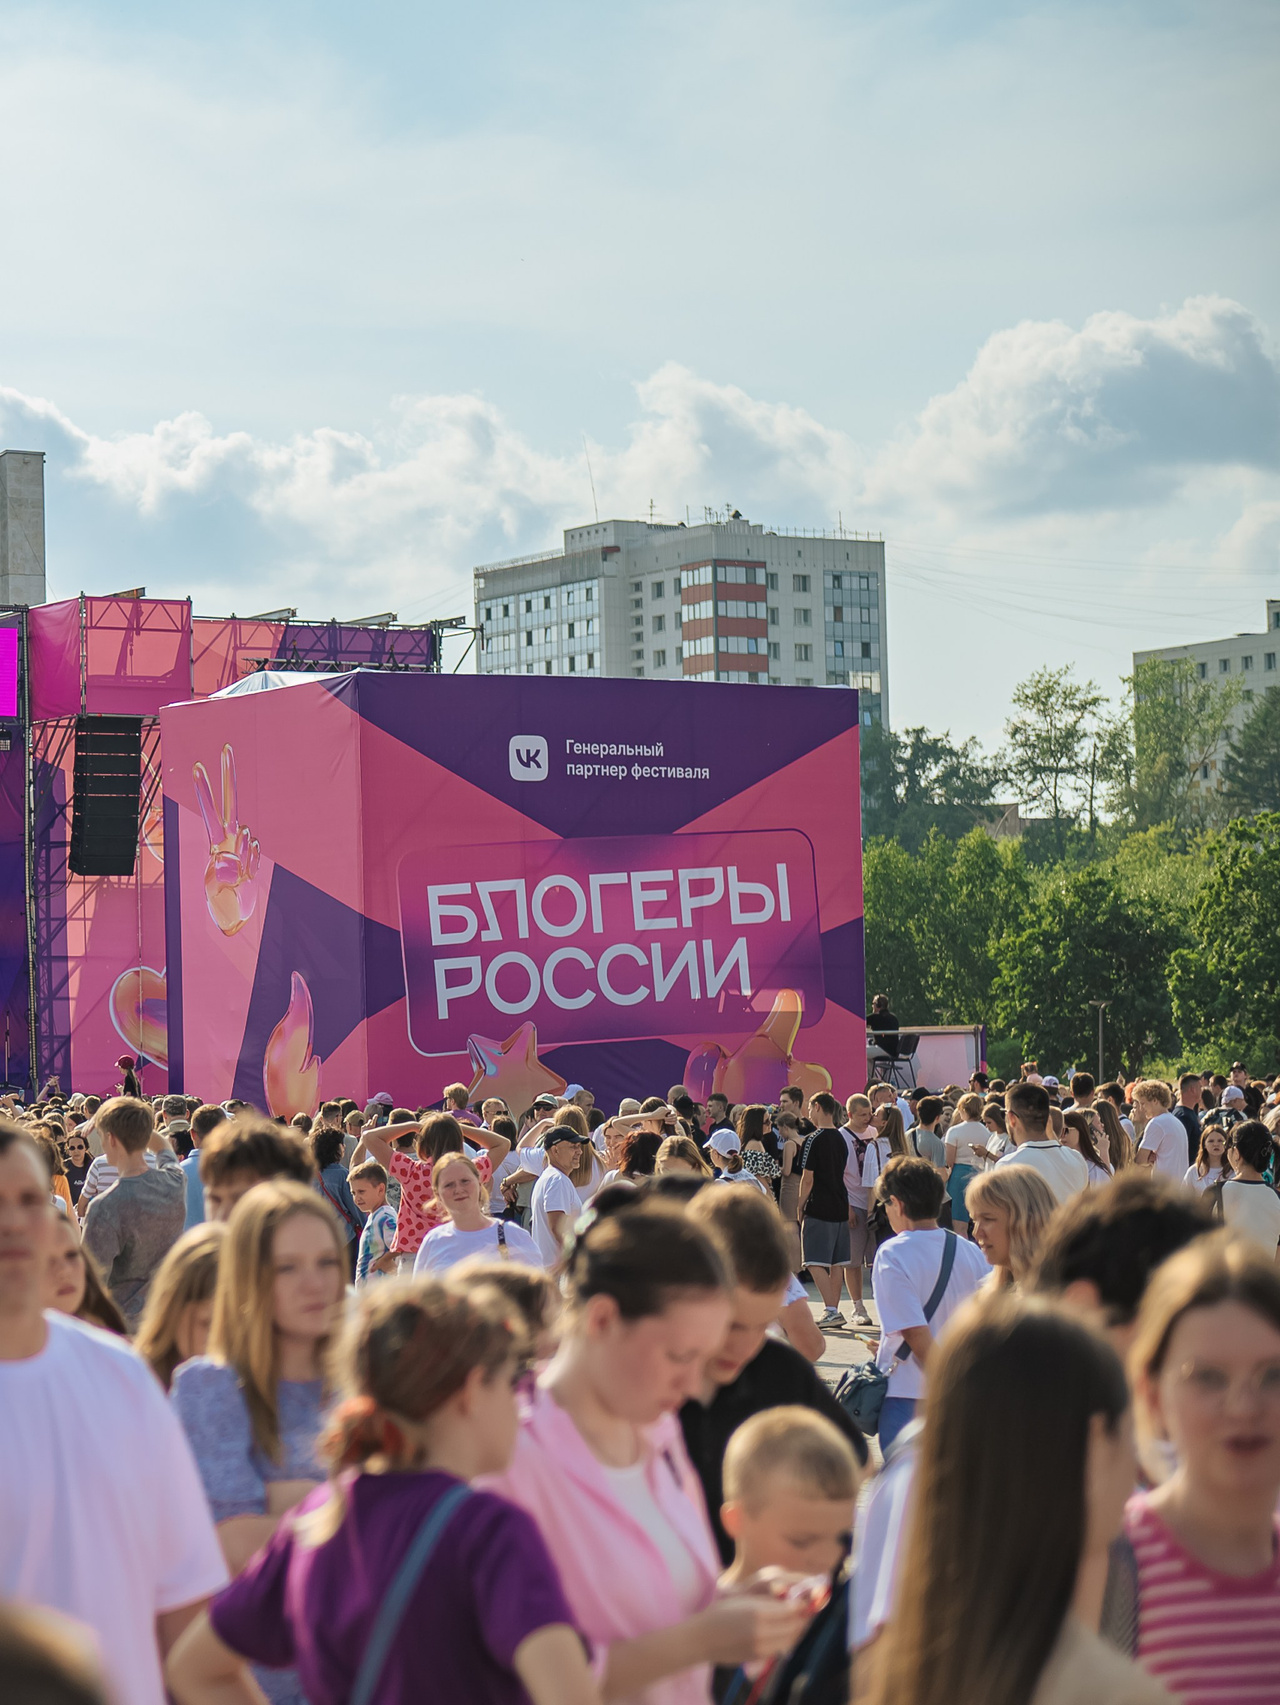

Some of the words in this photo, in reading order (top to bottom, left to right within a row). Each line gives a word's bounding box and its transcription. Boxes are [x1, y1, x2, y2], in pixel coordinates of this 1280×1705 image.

[515, 748, 542, 769] VK
[565, 739, 664, 758] Генеральный
[565, 762, 628, 780] партнер
[630, 762, 710, 780] фестиваля
[426, 862, 792, 946] БЛОГЕРЫ
[432, 936, 752, 1020] РОССИИ
